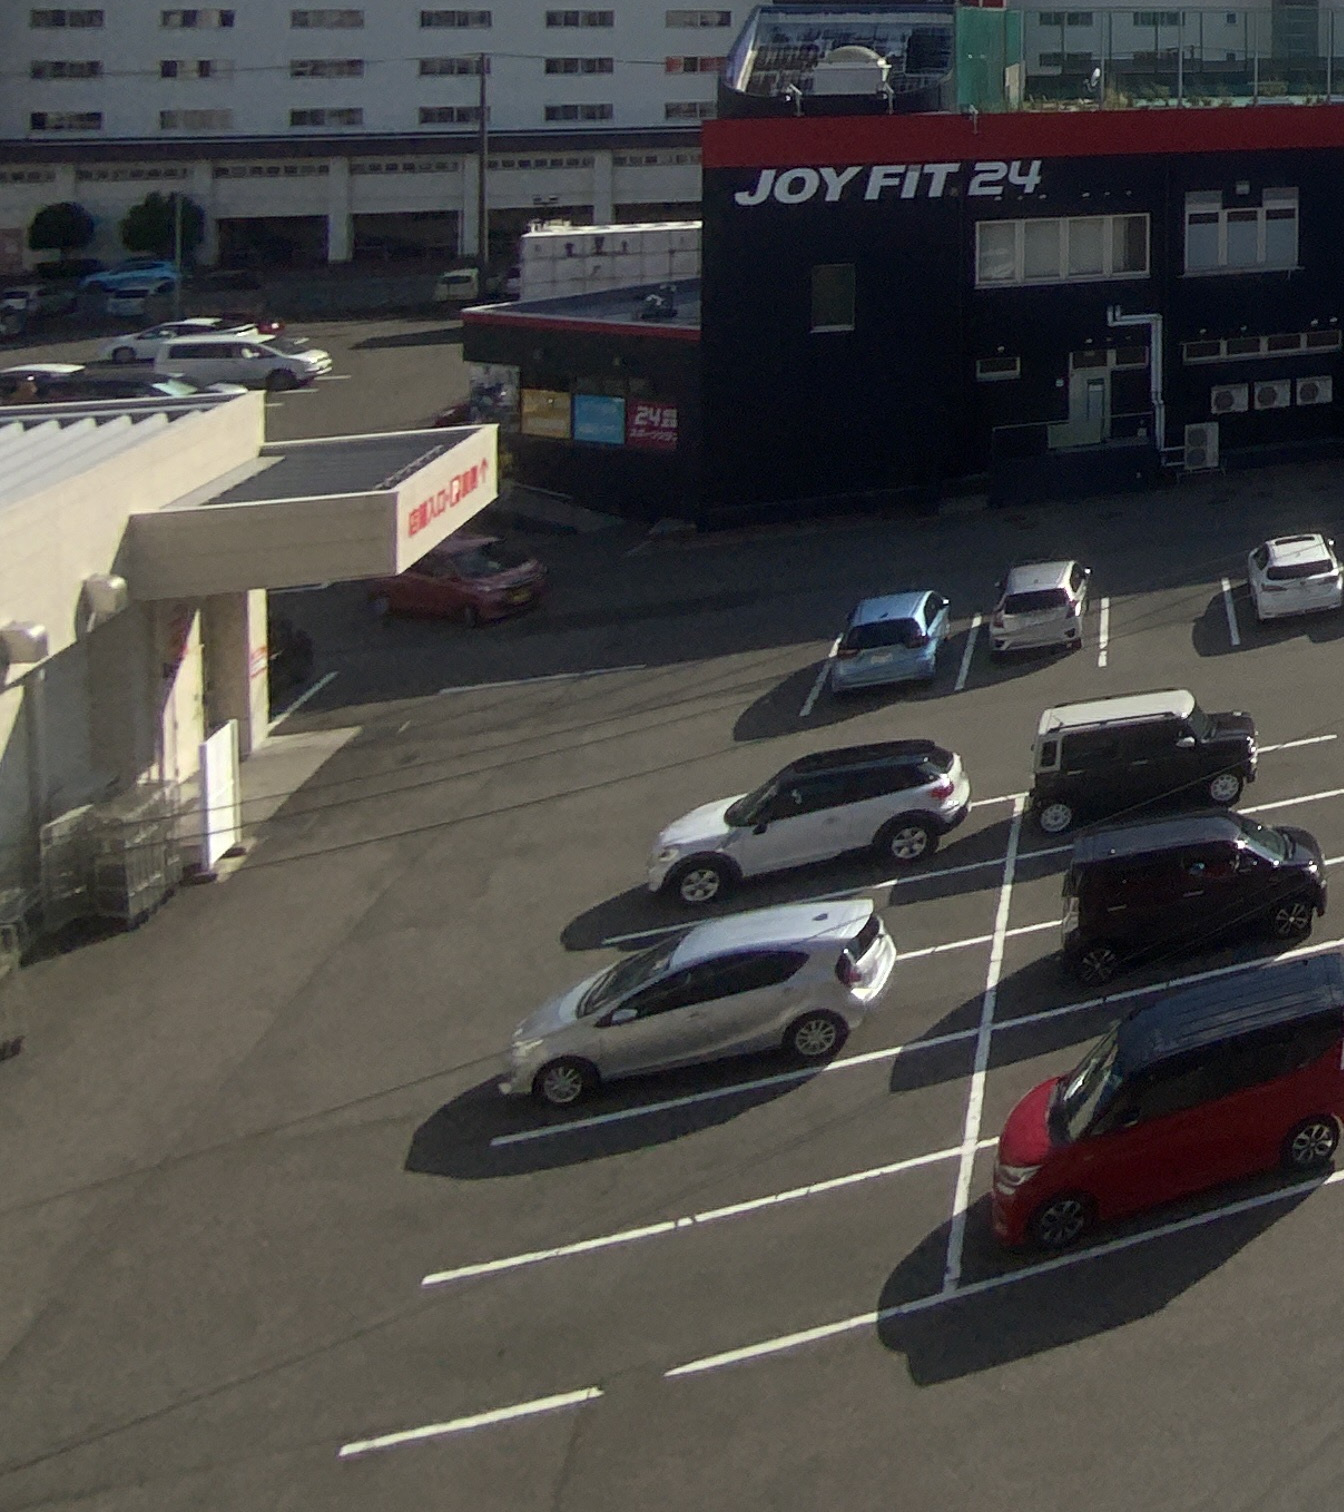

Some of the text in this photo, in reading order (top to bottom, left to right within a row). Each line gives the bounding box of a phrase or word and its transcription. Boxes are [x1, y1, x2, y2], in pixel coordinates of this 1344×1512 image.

[734, 160, 1042, 206] JOY FIT 24
